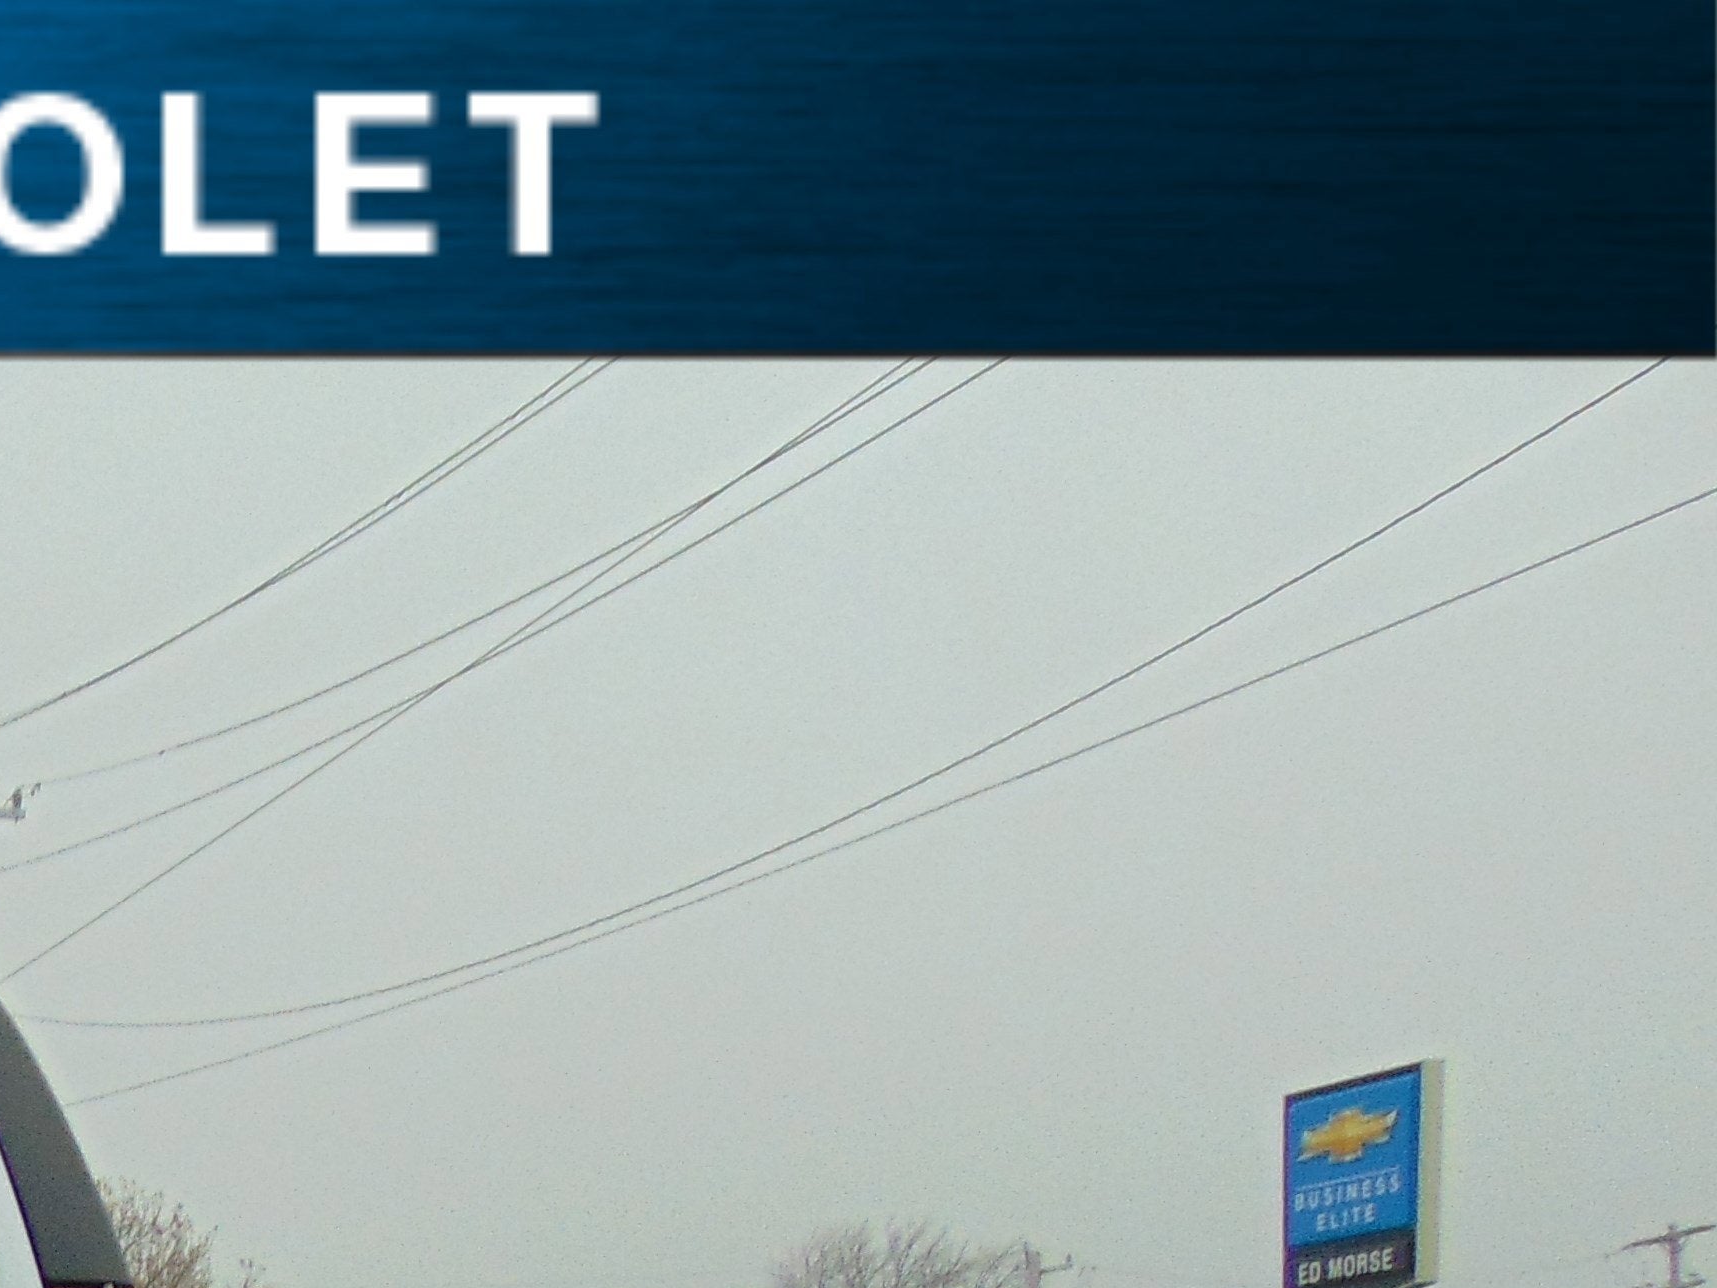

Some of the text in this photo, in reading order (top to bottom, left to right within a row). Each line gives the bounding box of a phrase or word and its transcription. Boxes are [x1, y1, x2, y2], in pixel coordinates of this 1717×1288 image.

[1294, 1172, 1401, 1212] BUSINESS
[1317, 1202, 1376, 1232] ELITE
[1298, 1247, 1394, 1286] ED MORSE
